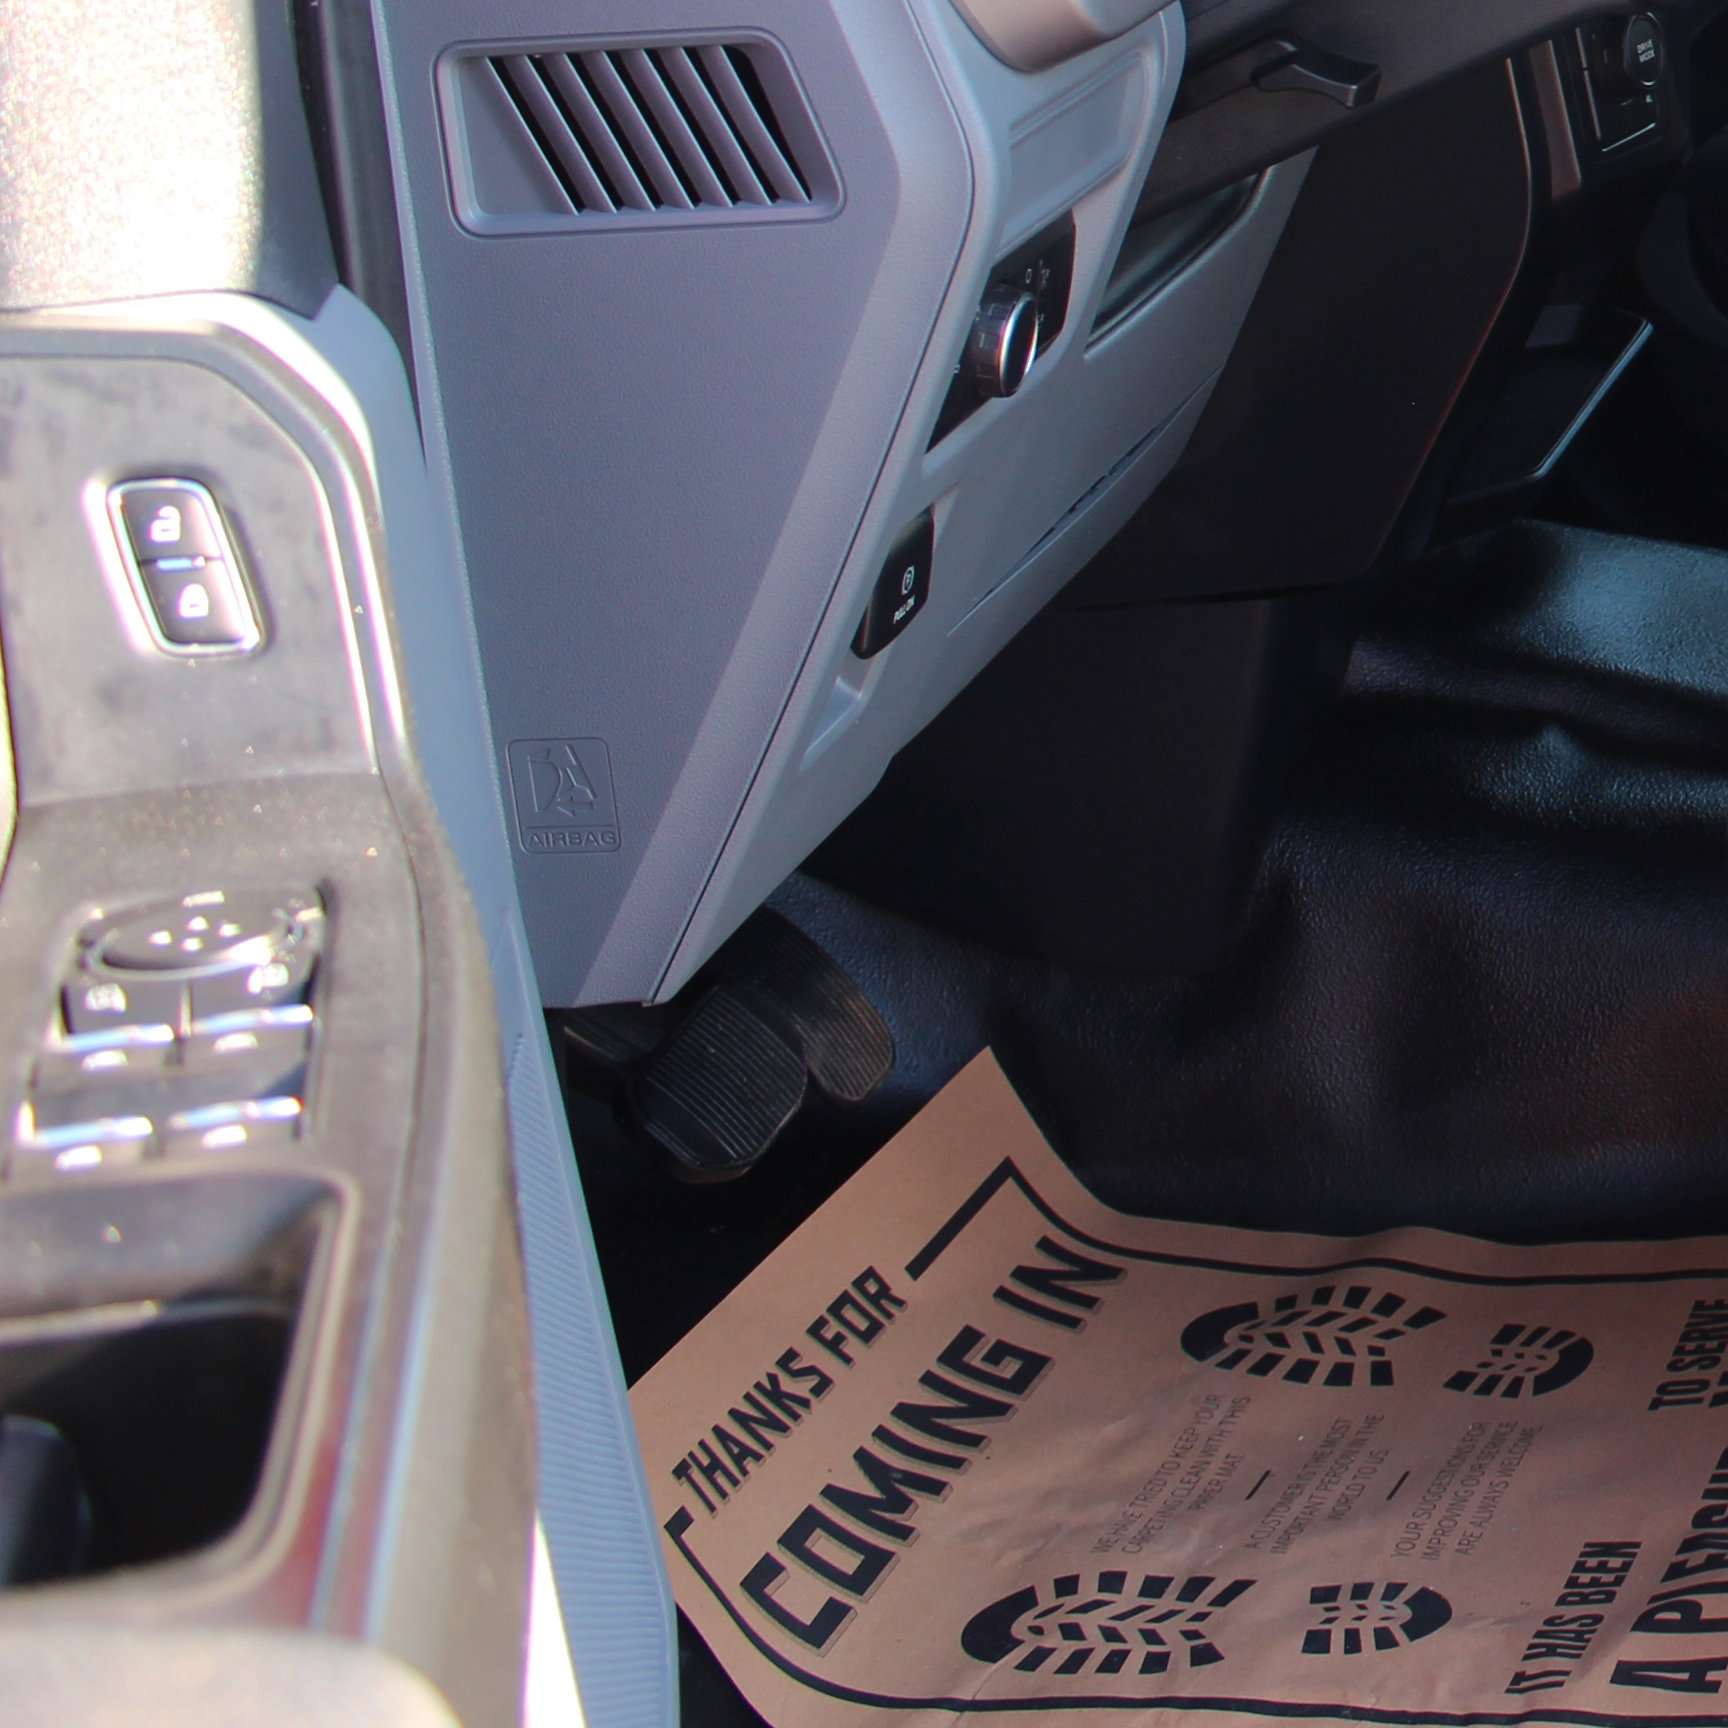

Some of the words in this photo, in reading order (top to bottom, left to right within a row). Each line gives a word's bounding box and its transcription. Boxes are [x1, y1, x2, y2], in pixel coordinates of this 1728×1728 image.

[527, 830, 618, 848] AIRBAG
[671, 1347, 836, 1517] THANKS
[806, 1265, 908, 1368] FOR
[1648, 1379, 1711, 1411] TO
[739, 1324, 1056, 1657] COMING
[991, 1235, 1127, 1335] IN
[1129, 1478, 1167, 1508] TRIED
[1155, 1461, 1180, 1476] TO
[1169, 1427, 1200, 1459] KEEP
[1193, 1394, 1223, 1424] YOUR
[1320, 1417, 1352, 1448] MOST
[1347, 1439, 1368, 1454] IN
[1356, 1414, 1385, 1436] THE
[1122, 1499, 1183, 1554] CARPETING
[1171, 1461, 1210, 1497] CLEAN
[1199, 1428, 1233, 1458] WITH
[1219, 1396, 1250, 1425] THIS
[1296, 1471, 1317, 1481] IS
[1303, 1450, 1333, 1470] THE
[1315, 1458, 1354, 1491] PERSON
[1188, 1478, 1225, 1510] PAPER
[1251, 1483, 1305, 1540] CUSTOMER
[1326, 1483, 1365, 1521] WORLD
[1352, 1466, 1377, 1480] TO
[1391, 1521, 1426, 1558] YOUR
[1412, 1444, 1476, 1519] SUGGESTIONS
[1462, 1422, 1490, 1442] FOR
[1420, 1490, 1474, 1560] IMPROVING
[1461, 1463, 1490, 1487] OUR
[1476, 1422, 1518, 1462] SERVICE
[1269, 1494, 1327, 1554] IMPORTANT
[1455, 1530, 1483, 1555] ARE
[1470, 1481, 1509, 1528] ALWAYS
[1554, 1541, 1642, 1607] BEEN
[1521, 1613, 1605, 1662] HAS
[1504, 1669, 1572, 1695] IT
